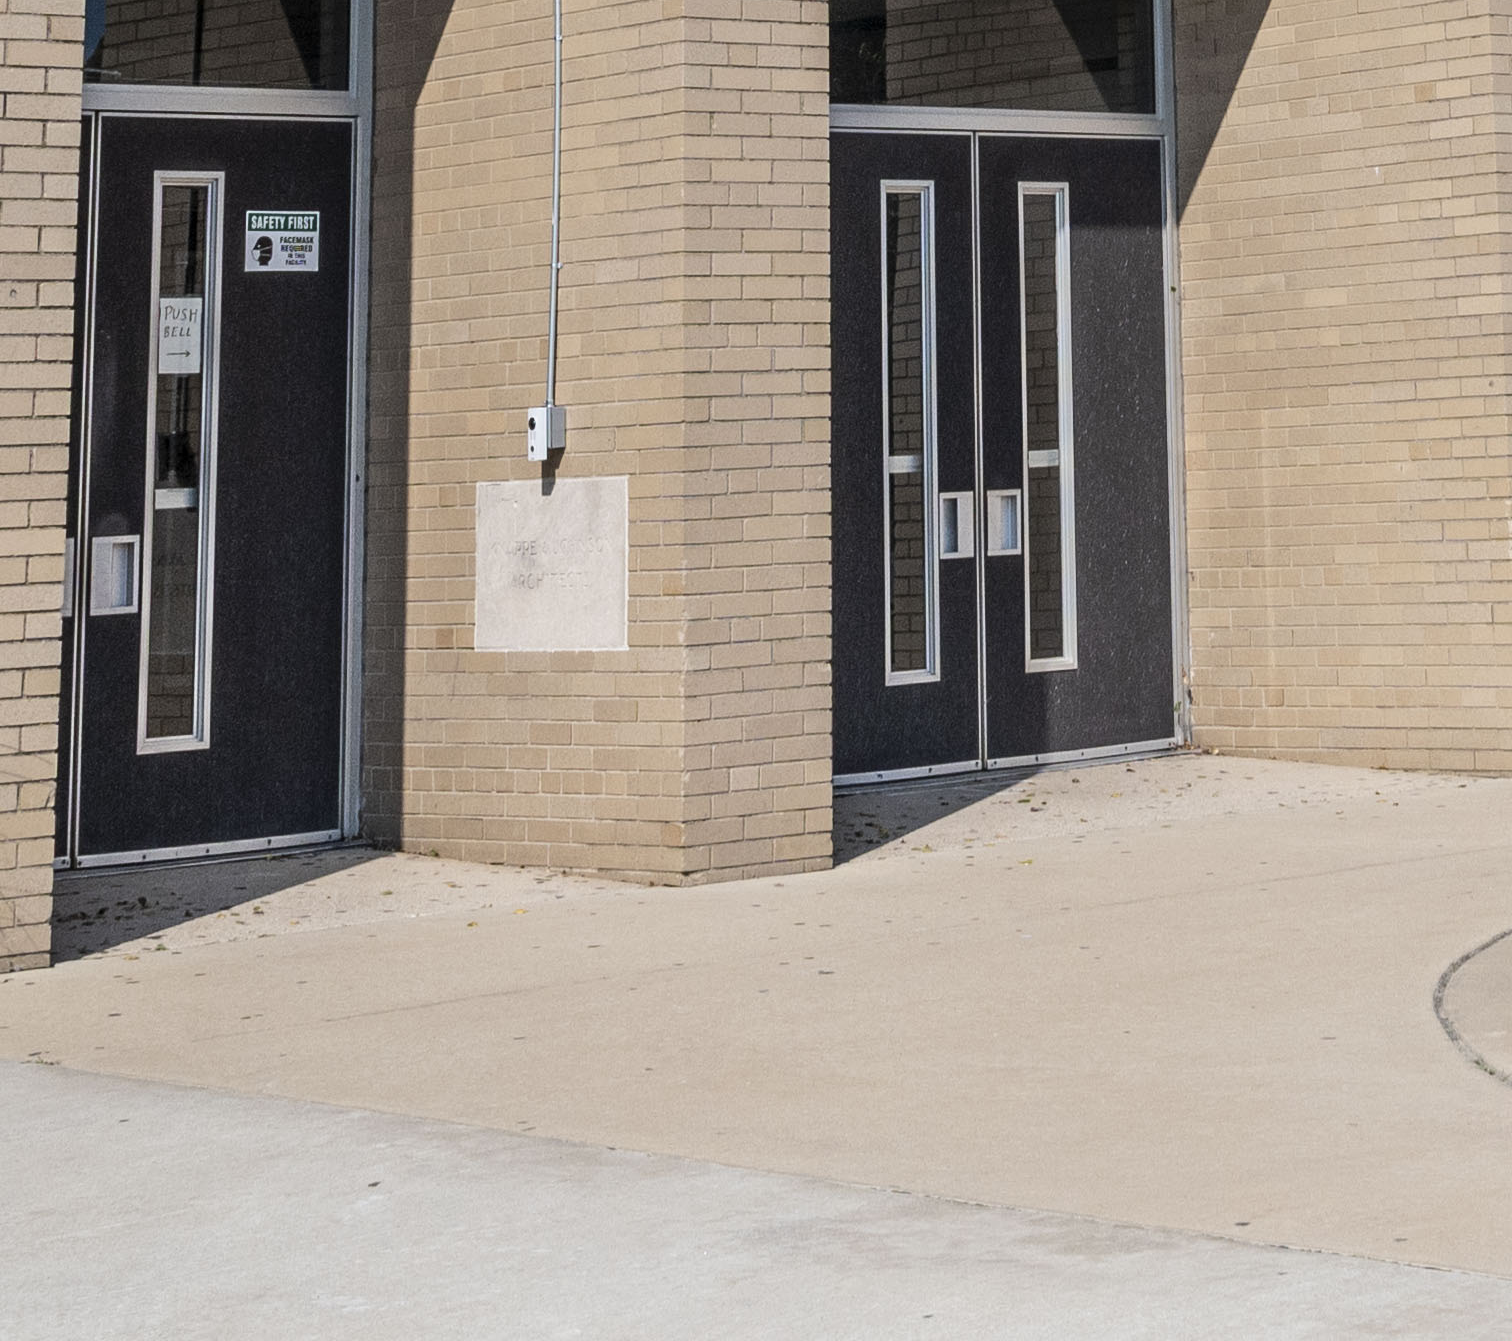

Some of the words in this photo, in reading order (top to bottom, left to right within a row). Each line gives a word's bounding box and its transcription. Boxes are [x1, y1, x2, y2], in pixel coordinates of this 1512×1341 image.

[251, 215, 286, 230] SAFETY
[288, 215, 315, 230] FIRST
[279, 236, 315, 244] FACEMASK
[164, 305, 198, 324] PUSH
[163, 325, 192, 338] BELL
